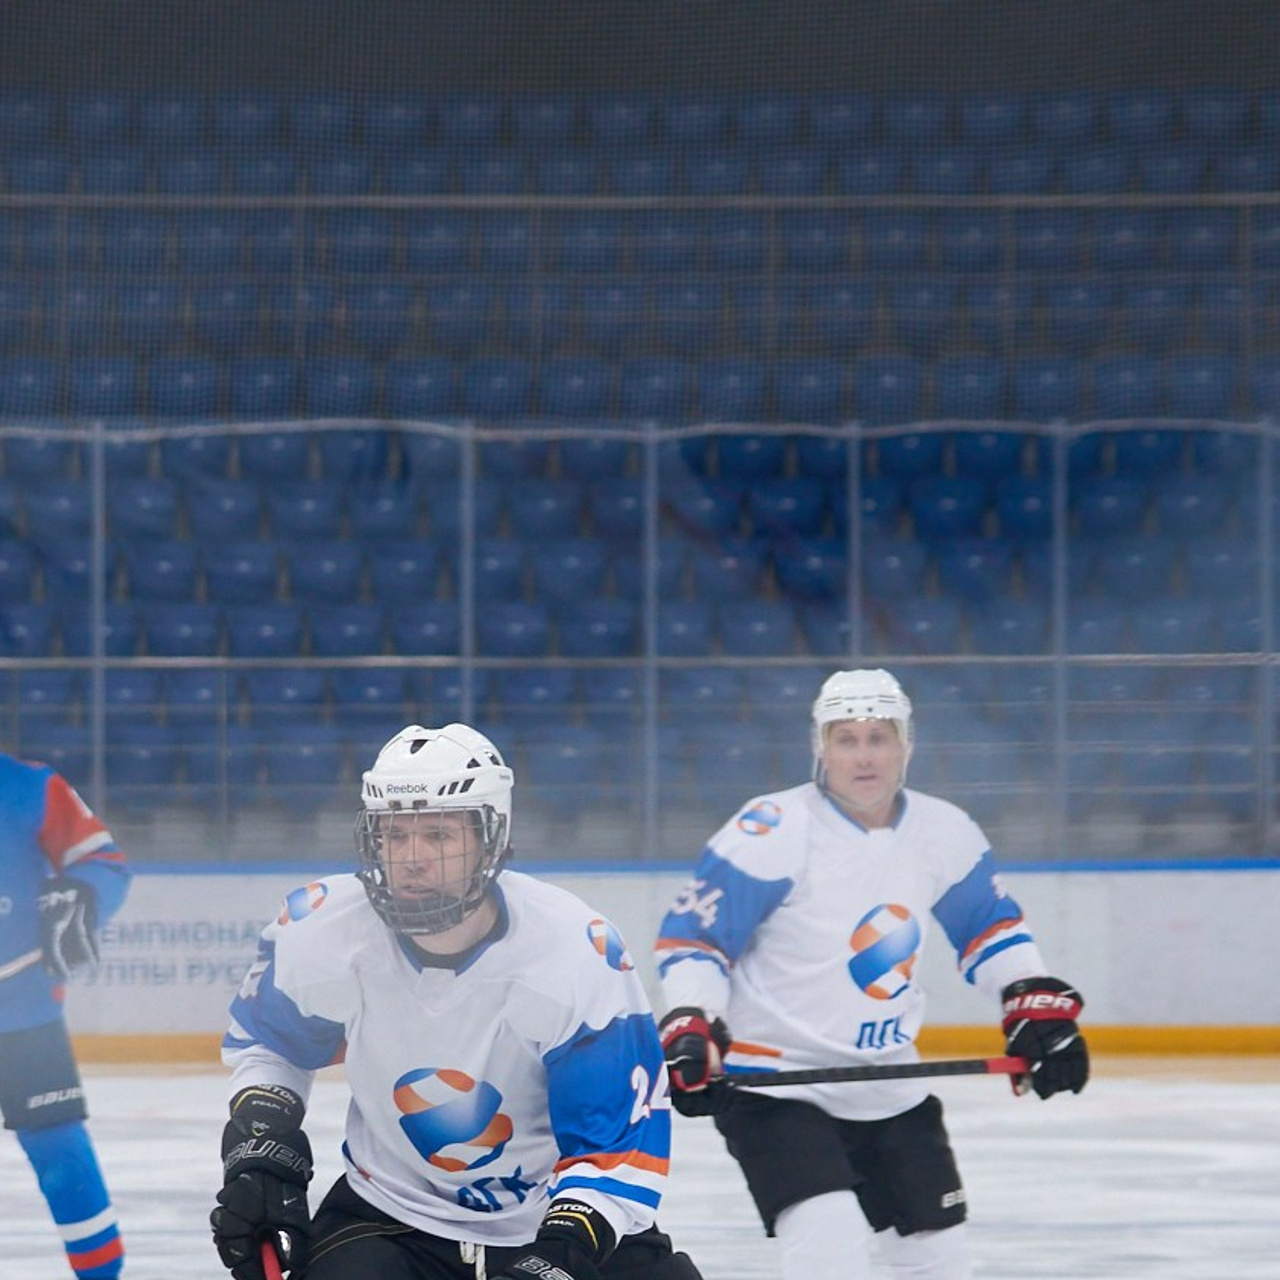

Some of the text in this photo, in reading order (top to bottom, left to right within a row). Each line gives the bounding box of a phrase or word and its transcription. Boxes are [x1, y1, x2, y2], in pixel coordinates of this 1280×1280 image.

[386, 783, 428, 794] Reebok
[99, 920, 268, 945] ЕМПИОНА
[185, 956, 252, 987] РУС
